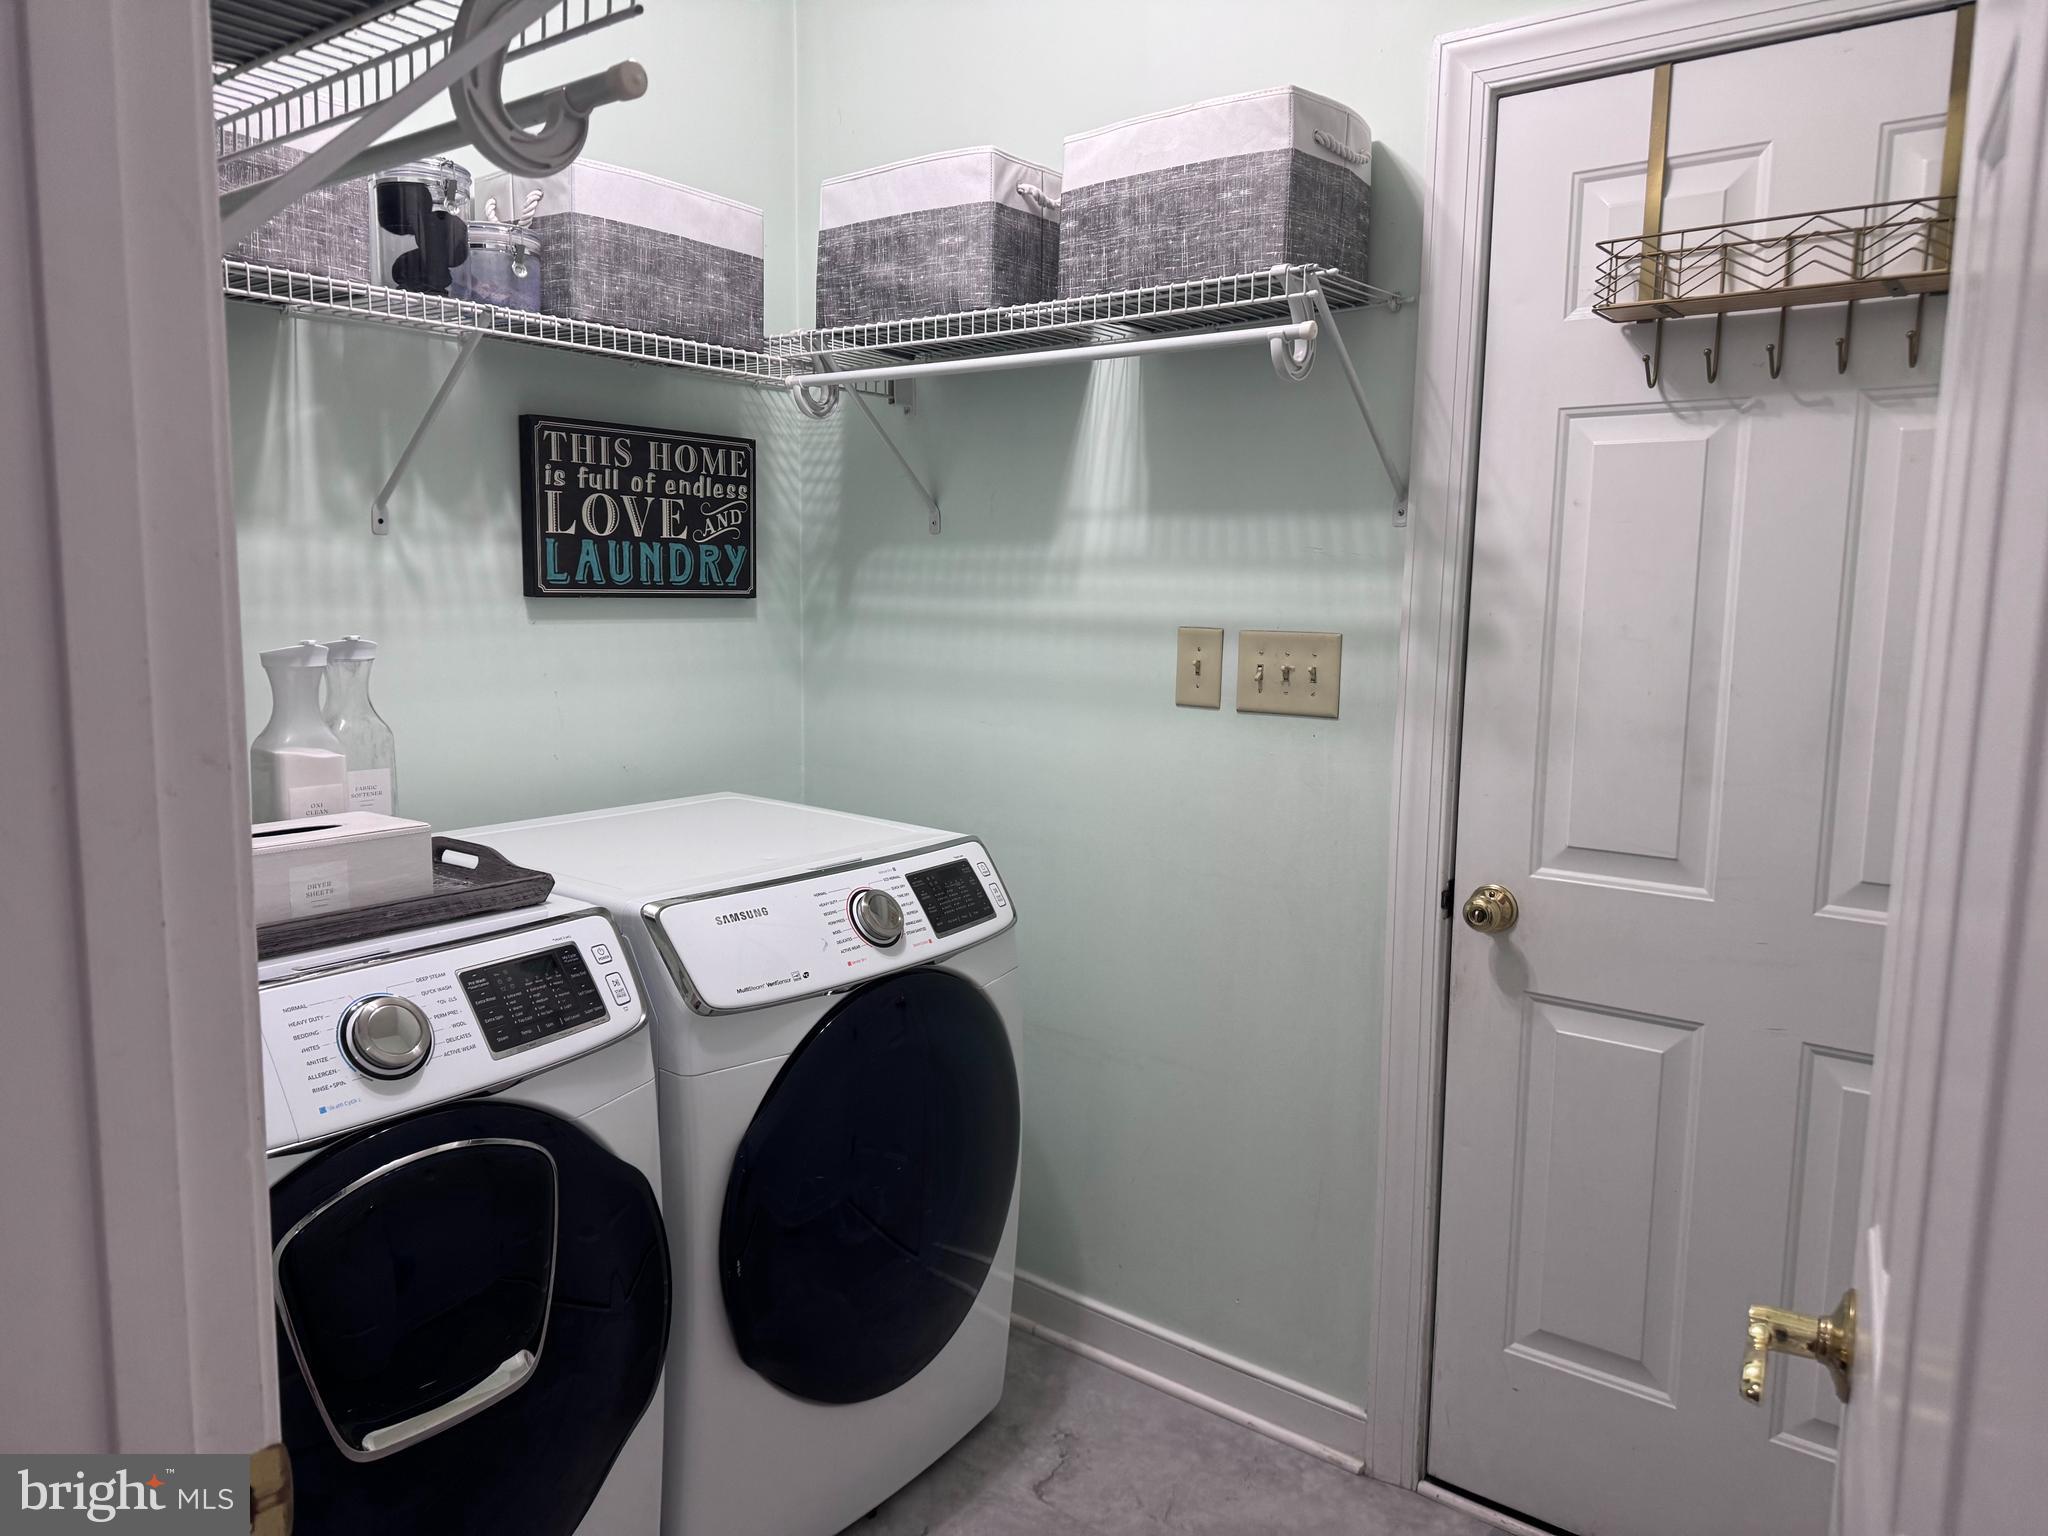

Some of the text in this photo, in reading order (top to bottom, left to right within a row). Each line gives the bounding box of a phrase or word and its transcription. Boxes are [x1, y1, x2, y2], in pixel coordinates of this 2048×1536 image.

[543, 430, 748, 478] THIS HOME
[544, 464, 748, 499] is full of endless
[544, 490, 743, 540] LOVE AND
[545, 538, 748, 586] LAUNDRY
[351, 790, 383, 799] SOFTENER
[307, 881, 332, 890] DRYER
[305, 888, 334, 898] SHEETS
[715, 906, 769, 925] SAMSUNG
[421, 989, 437, 997] QUICK
[282, 1004, 308, 1013] NORMAL
[288, 1015, 324, 1028] HEAVY DUTY
[293, 1030, 320, 1041] BEDDING
[446, 1032, 472, 1044] DELICATES
[444, 1044, 477, 1057] ACTIVE WEAR
[306, 1056, 329, 1066] ANITIZE
[307, 1069, 337, 1081] ALLERGEN
